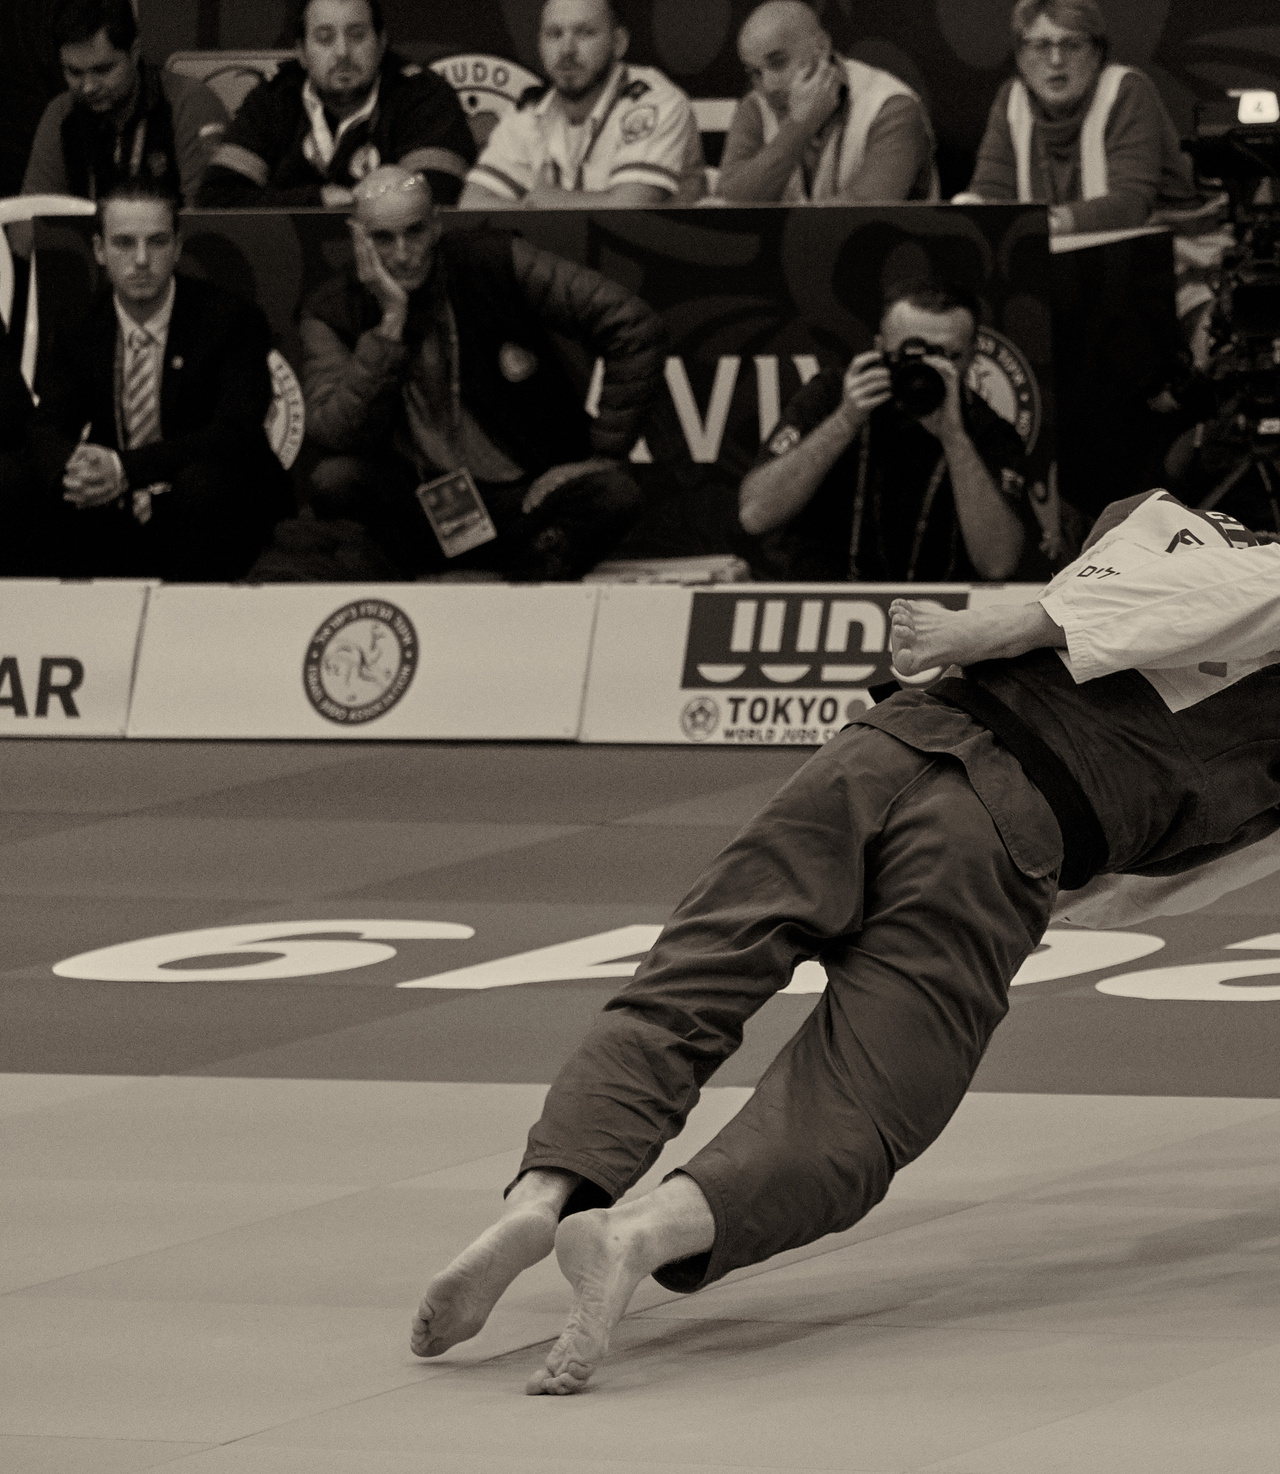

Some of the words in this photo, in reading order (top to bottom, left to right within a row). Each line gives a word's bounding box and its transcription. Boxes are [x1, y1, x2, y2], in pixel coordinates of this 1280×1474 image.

[443, 61, 511, 88] UDO
[696, 599, 946, 684] JUD
[727, 697, 839, 725] TOKYO
